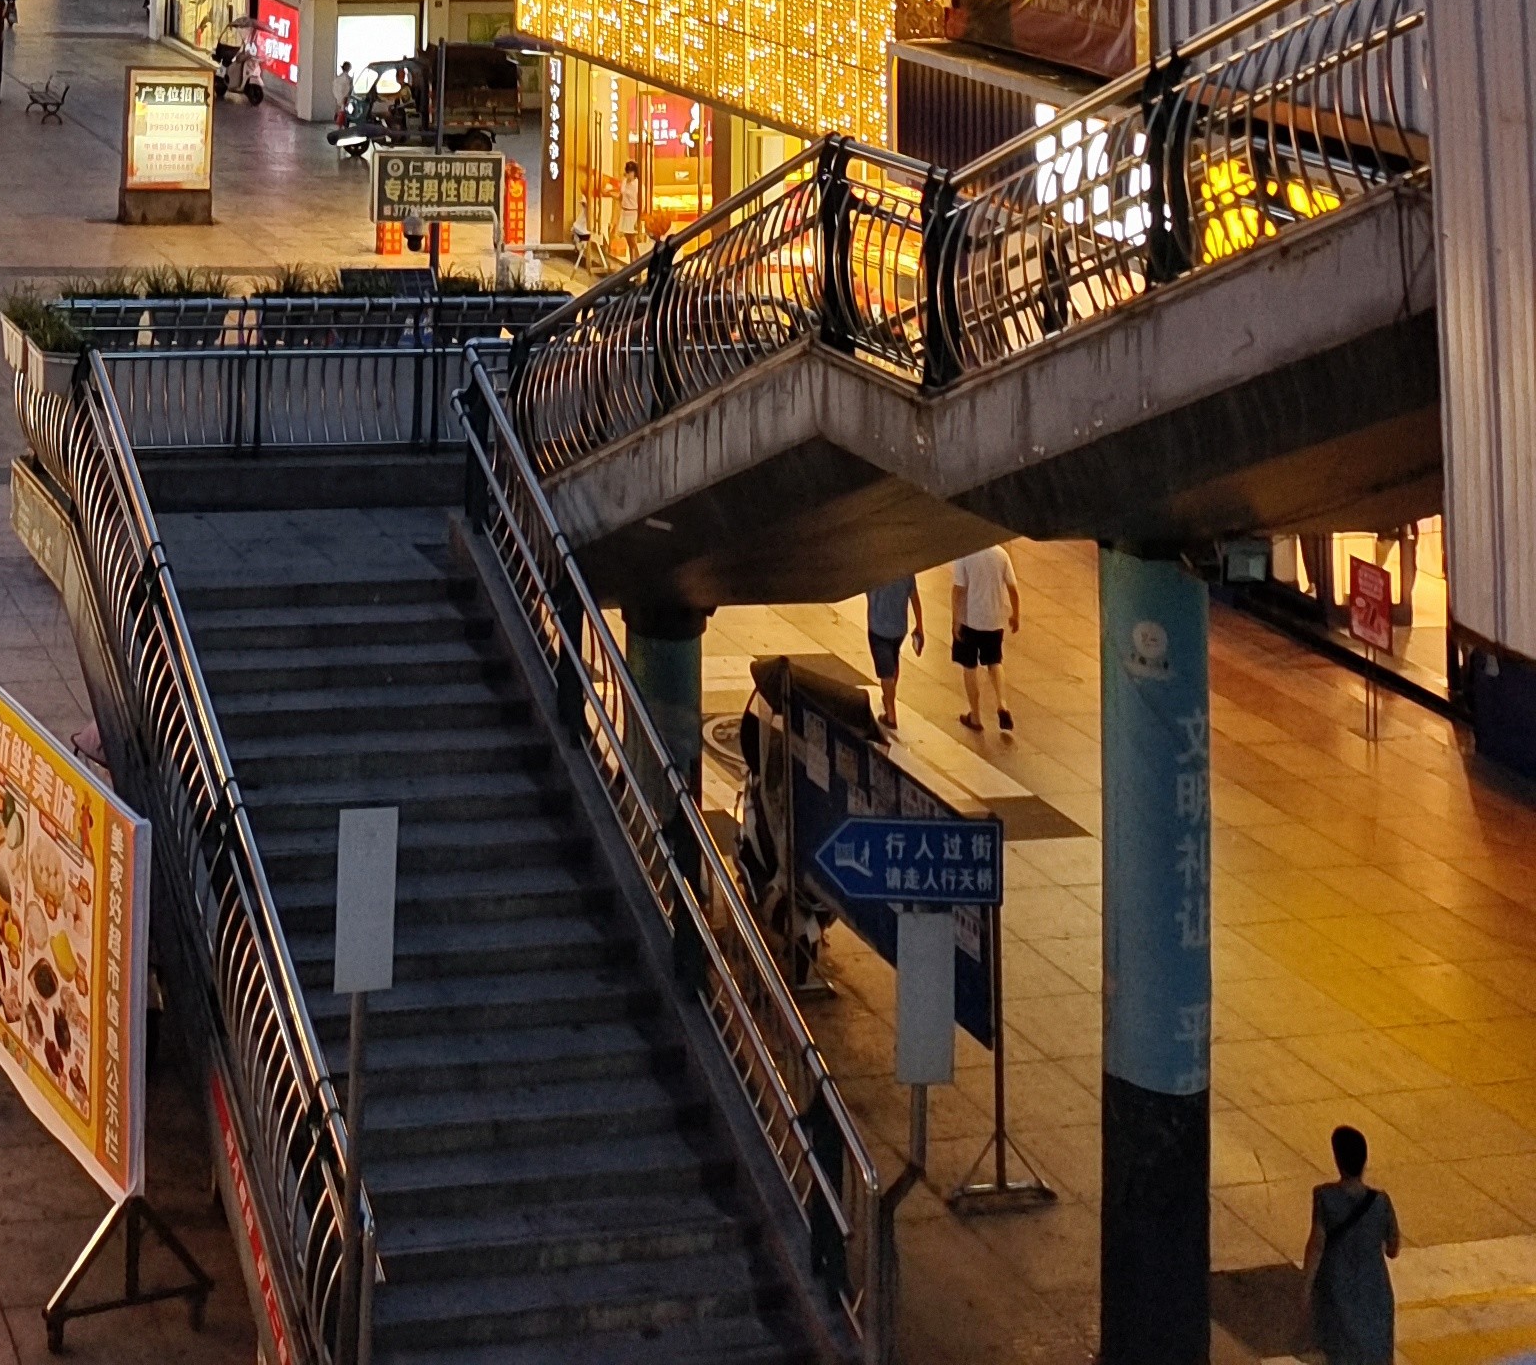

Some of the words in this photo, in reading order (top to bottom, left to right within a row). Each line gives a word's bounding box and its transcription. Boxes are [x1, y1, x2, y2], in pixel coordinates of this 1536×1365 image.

[140, 86, 205, 103] 广告位招商
[409, 161, 493, 177] 仁寿中南医院
[385, 179, 496, 202] 专注男性健康
[885, 832, 992, 862] 行人过街
[885, 867, 993, 891] 请走人行天桥
